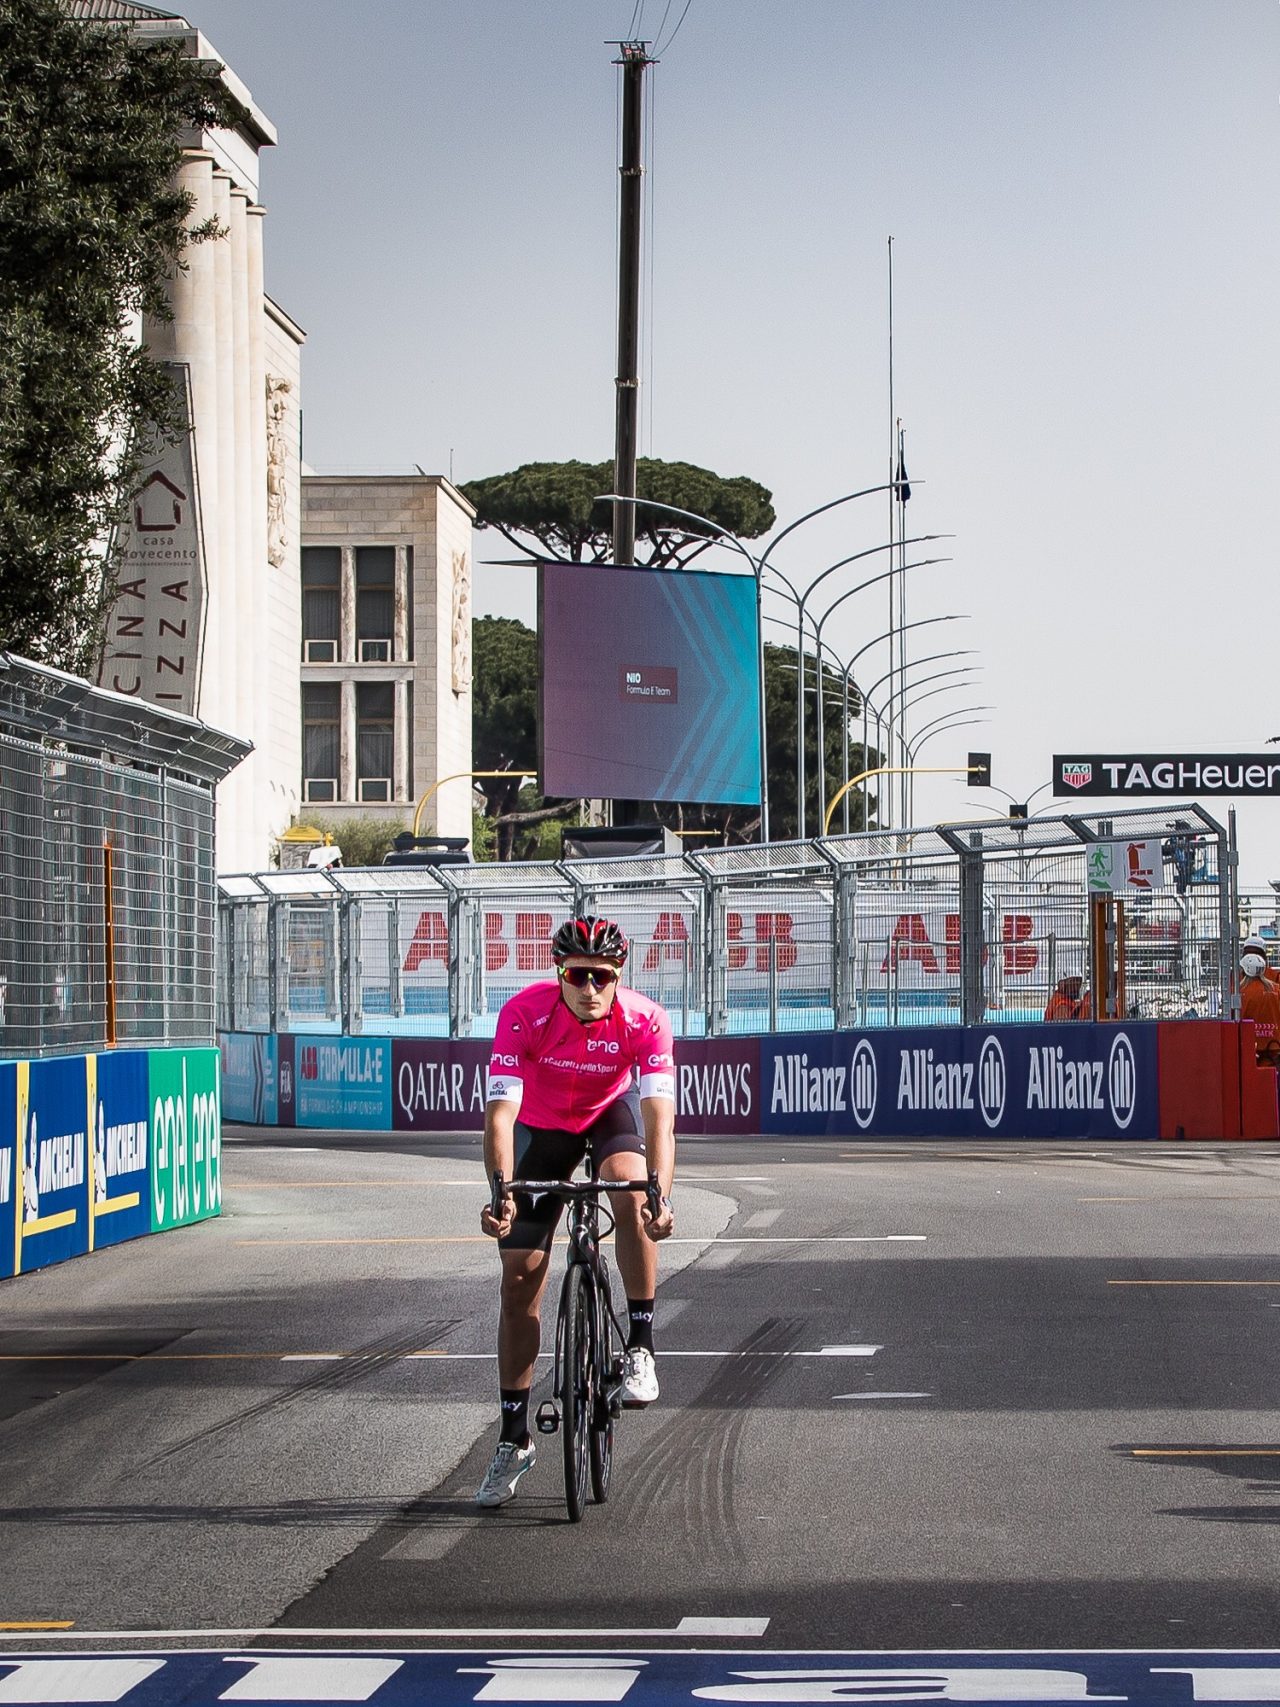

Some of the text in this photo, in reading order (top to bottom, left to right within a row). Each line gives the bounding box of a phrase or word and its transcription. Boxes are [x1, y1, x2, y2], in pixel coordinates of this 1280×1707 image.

[143, 537, 174, 546] casa
[626, 684, 650, 695] Formula
[655, 686, 672, 697] Team
[1065, 765, 1089, 774] TAG
[398, 1061, 465, 1122] QATAR
[673, 1062, 752, 1117] IRWAYS
[770, 1053, 847, 1115] Allianz
[898, 1048, 975, 1111] Allianz
[1026, 1046, 1105, 1111] Allianz
[39, 1132, 85, 1195] MICHELIN
[106, 1120, 148, 1178] MICHELIN
[153, 1056, 190, 1226] enel
[631, 1311, 654, 1323] sky
